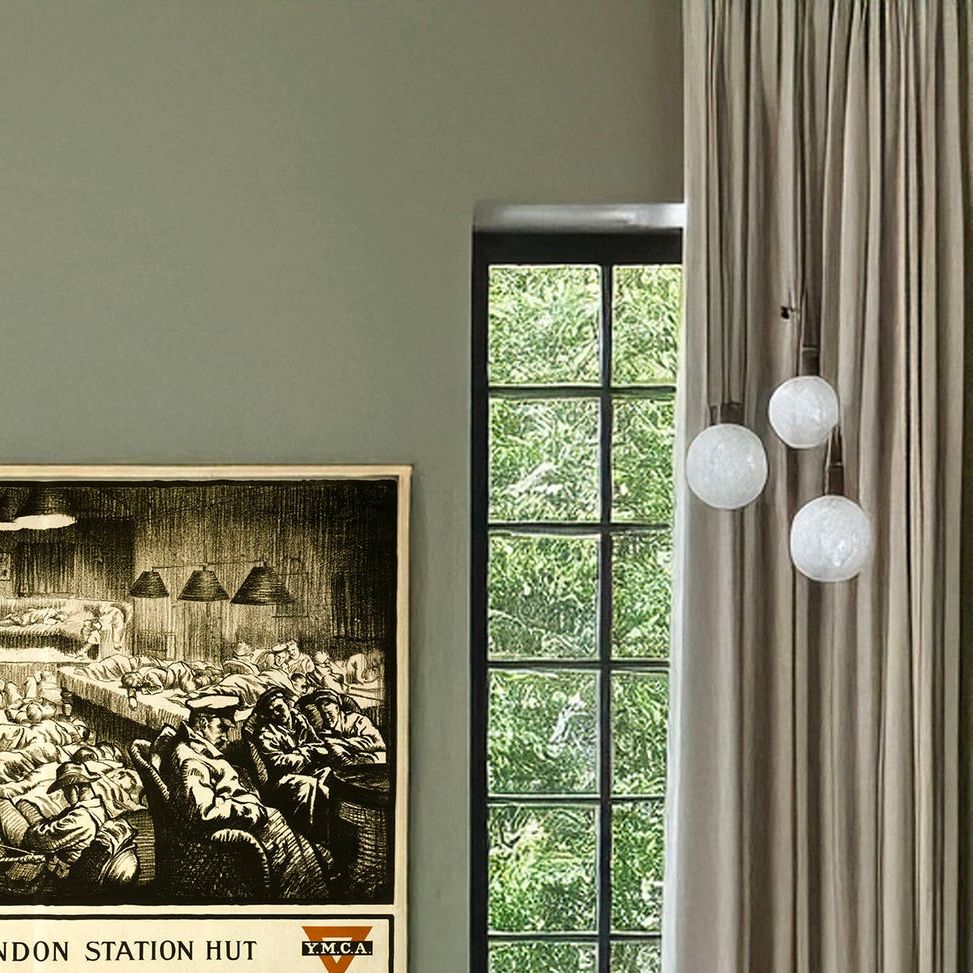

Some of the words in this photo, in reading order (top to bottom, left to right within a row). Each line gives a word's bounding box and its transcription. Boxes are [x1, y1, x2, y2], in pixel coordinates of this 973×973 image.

[84, 940, 194, 962] STATION
[206, 939, 258, 961] HUT
[303, 941, 372, 954] Y.M.C.A.
